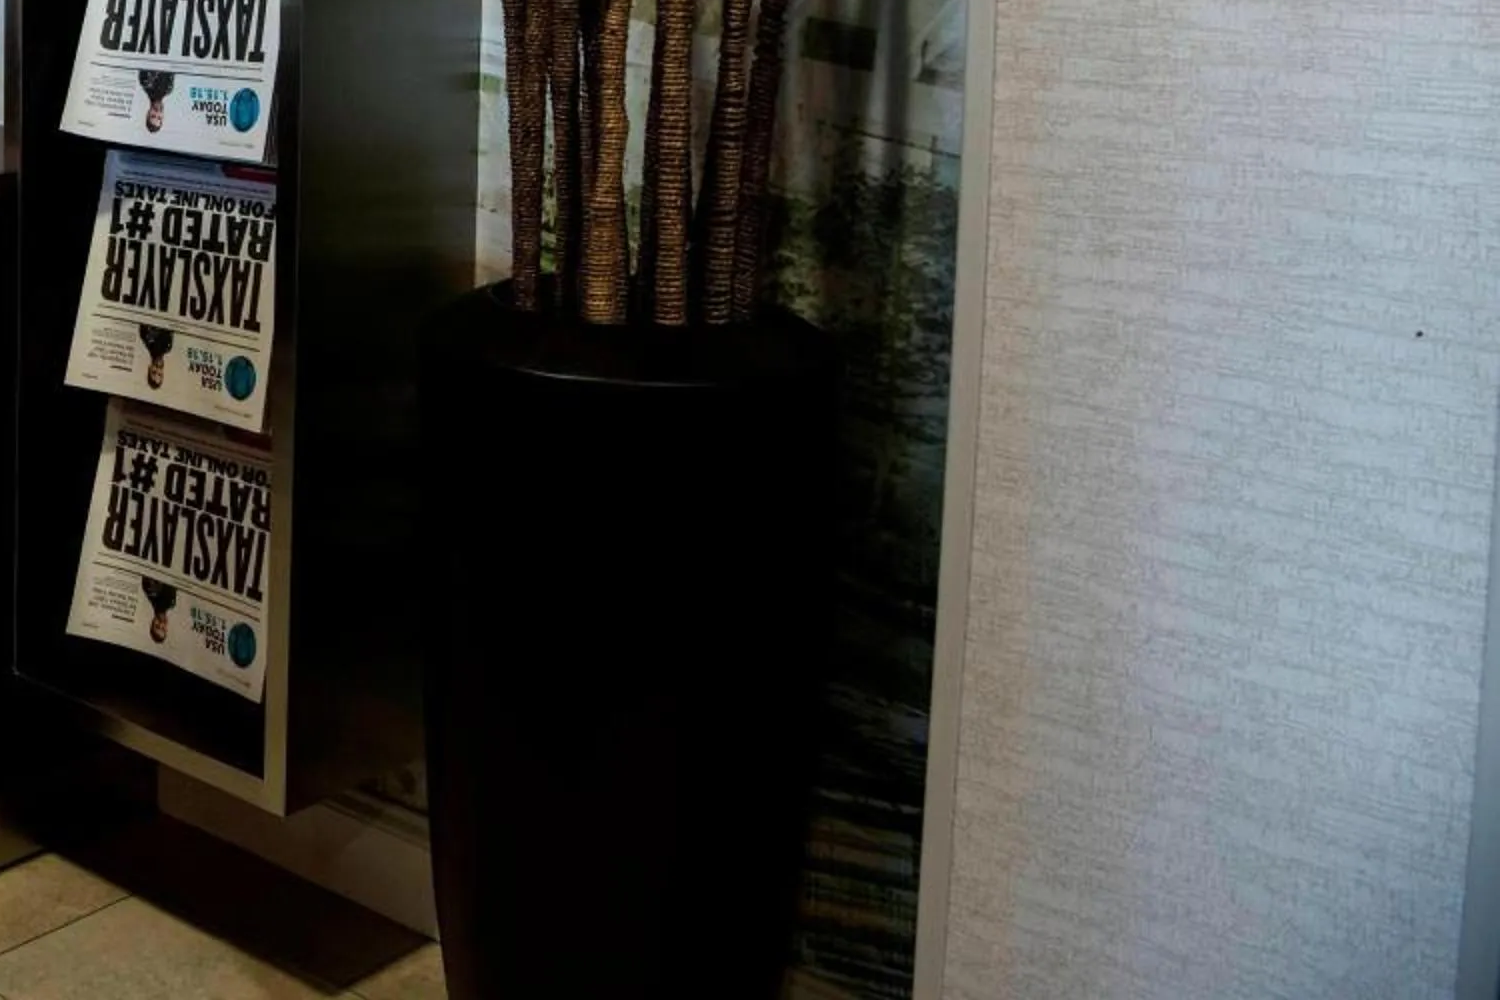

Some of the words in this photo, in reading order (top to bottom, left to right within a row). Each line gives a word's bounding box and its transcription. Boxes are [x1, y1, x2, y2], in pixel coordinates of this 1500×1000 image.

[189, 87, 228, 101] 1.15.18
[191, 101, 228, 114] TODAY
[206, 114, 227, 127] USA
[115, 180, 166, 202] TAXES
[169, 191, 235, 215] ONLINE
[239, 199, 275, 220] FOR
[110, 198, 154, 240] #1
[161, 205, 274, 261] RATED
[101, 237, 262, 333] TAXSLAYER
[188, 362, 222, 378] TODAY
[201, 377, 222, 392] USA
[118, 430, 170, 460] TAXES
[112, 445, 158, 494] #1
[174, 445, 238, 478] ONLINE
[243, 466, 271, 488] OR
[164, 462, 272, 532] RATED
[101, 485, 266, 601] TAXSLAYER
[192, 621, 225, 641] TODAY
[205, 638, 225, 655] USA
